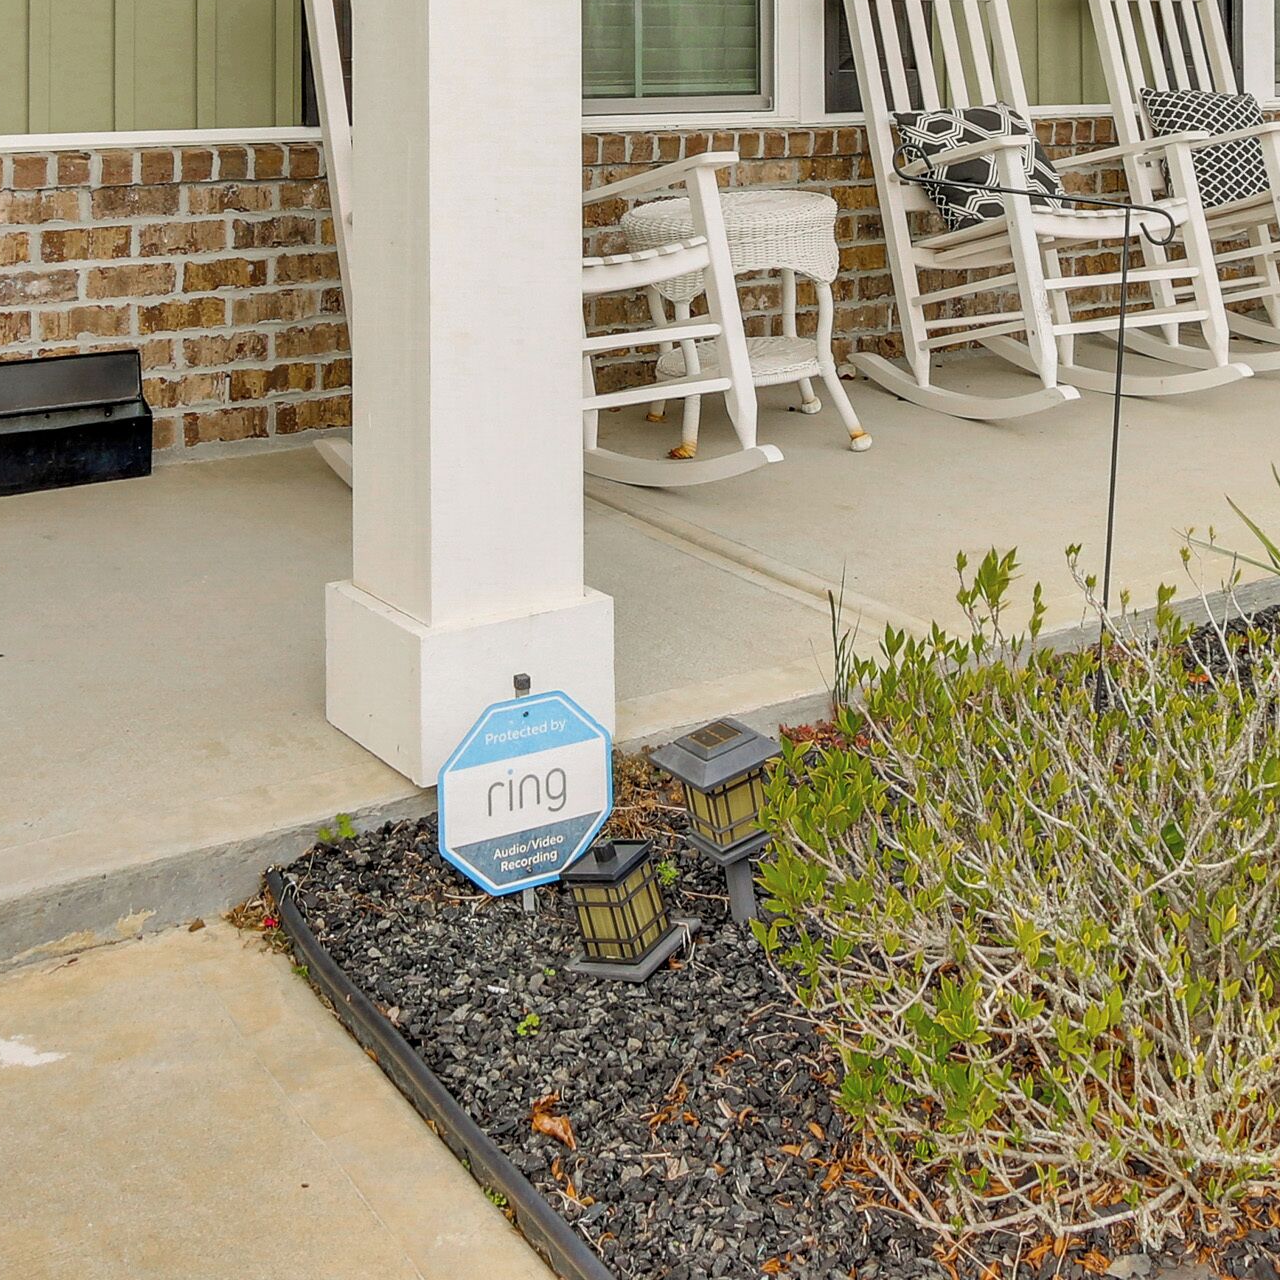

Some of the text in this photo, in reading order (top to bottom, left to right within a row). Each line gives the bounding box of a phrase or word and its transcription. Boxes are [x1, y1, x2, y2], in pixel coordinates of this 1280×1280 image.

[485, 718, 567, 745] Protected by
[488, 768, 567, 817] ring
[493, 833, 564, 860] Audio/Video
[500, 850, 558, 872] Recording
